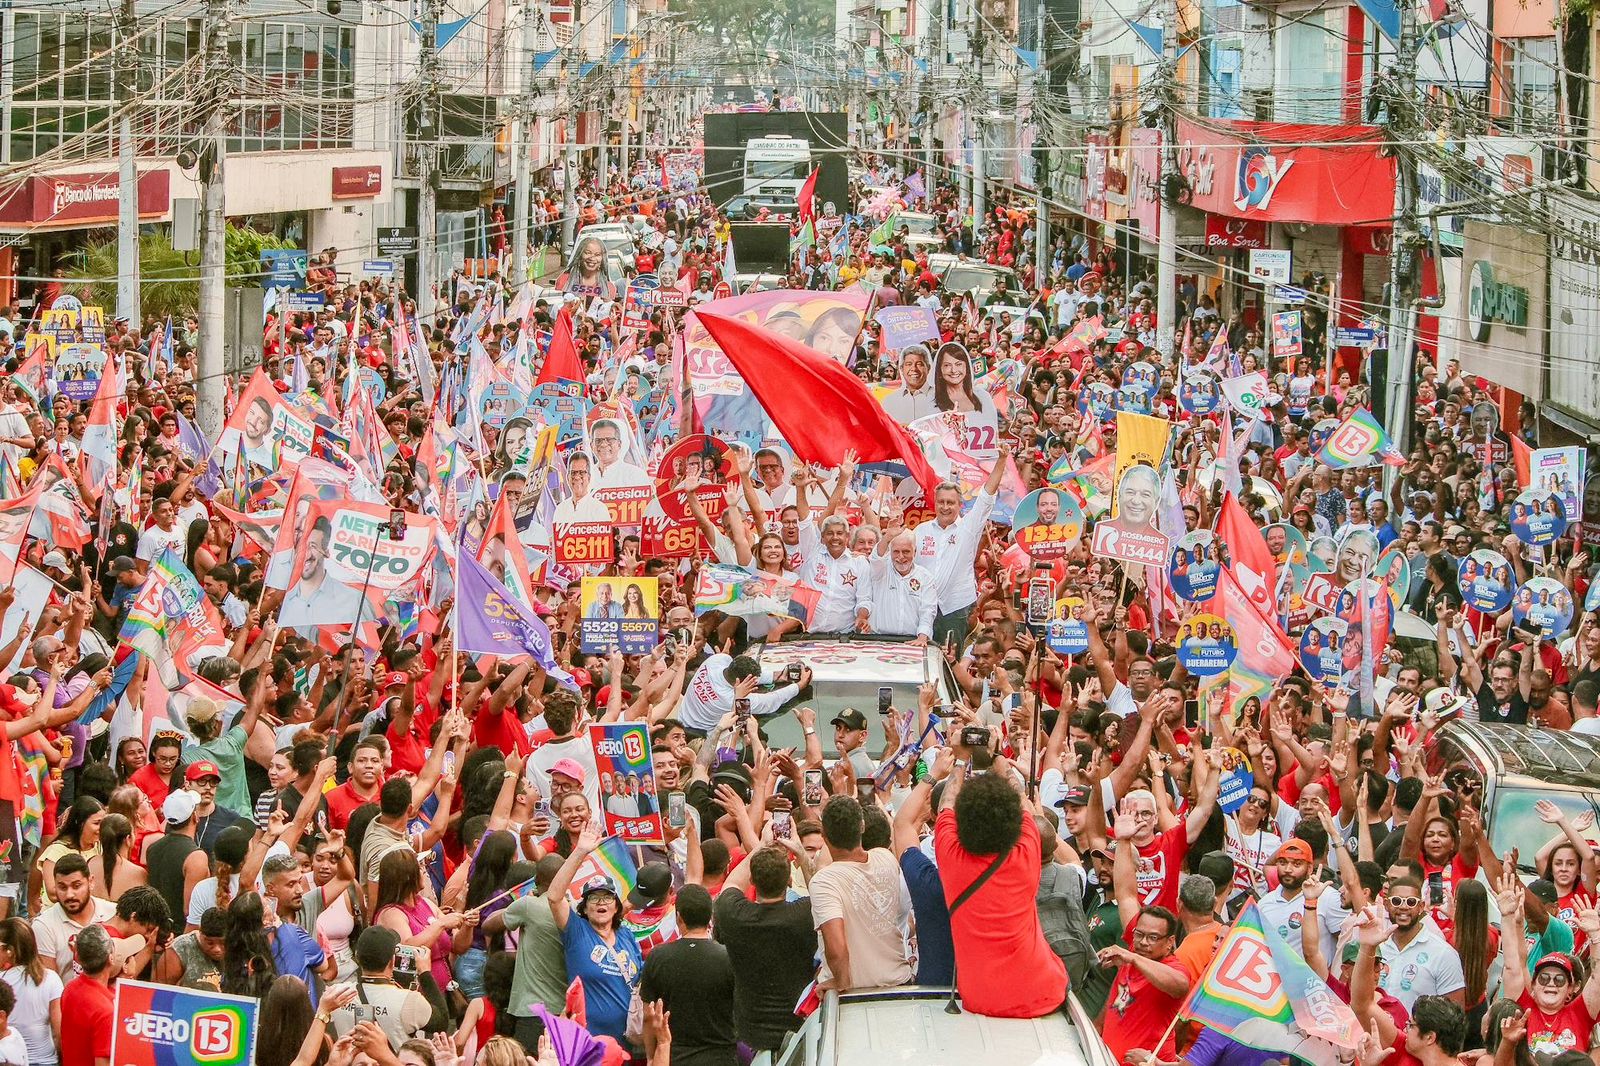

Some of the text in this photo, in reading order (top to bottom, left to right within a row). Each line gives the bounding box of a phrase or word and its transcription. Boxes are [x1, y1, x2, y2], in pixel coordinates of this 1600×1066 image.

[65, 184, 120, 203] Banco do Nordeste
[1208, 234, 1261, 248] Boa Sorte
[663, 296, 683, 305] 13444
[278, 411, 312, 438] NETO
[1339, 430, 1367, 453] 13
[1476, 451, 1505, 460] 1344
[593, 488, 650, 503] enceslau
[677, 491, 722, 505] Wceslau
[609, 499, 647, 525] 5111
[555, 521, 612, 539] Wenceslau
[1024, 522, 1079, 543] 1330
[1121, 531, 1165, 545] ROSEMBERG
[335, 529, 422, 557] CARLETTO
[563, 536, 610, 560] 65111
[1120, 542, 1165, 563] 13444
[333, 542, 411, 575] 7070
[583, 621, 656, 633] 5529 55670
[1050, 637, 1089, 647] BUERAREMA
[1200, 649, 1226, 657] FUTURO
[1186, 658, 1229, 668] BUERAREMA
[597, 737, 641, 757] JERO 13
[1220, 778, 1243, 793] FUTURO
[1217, 787, 1249, 806] ERAREMA
[1222, 939, 1280, 996] 13
[125, 1012, 230, 1052] JERO 13
